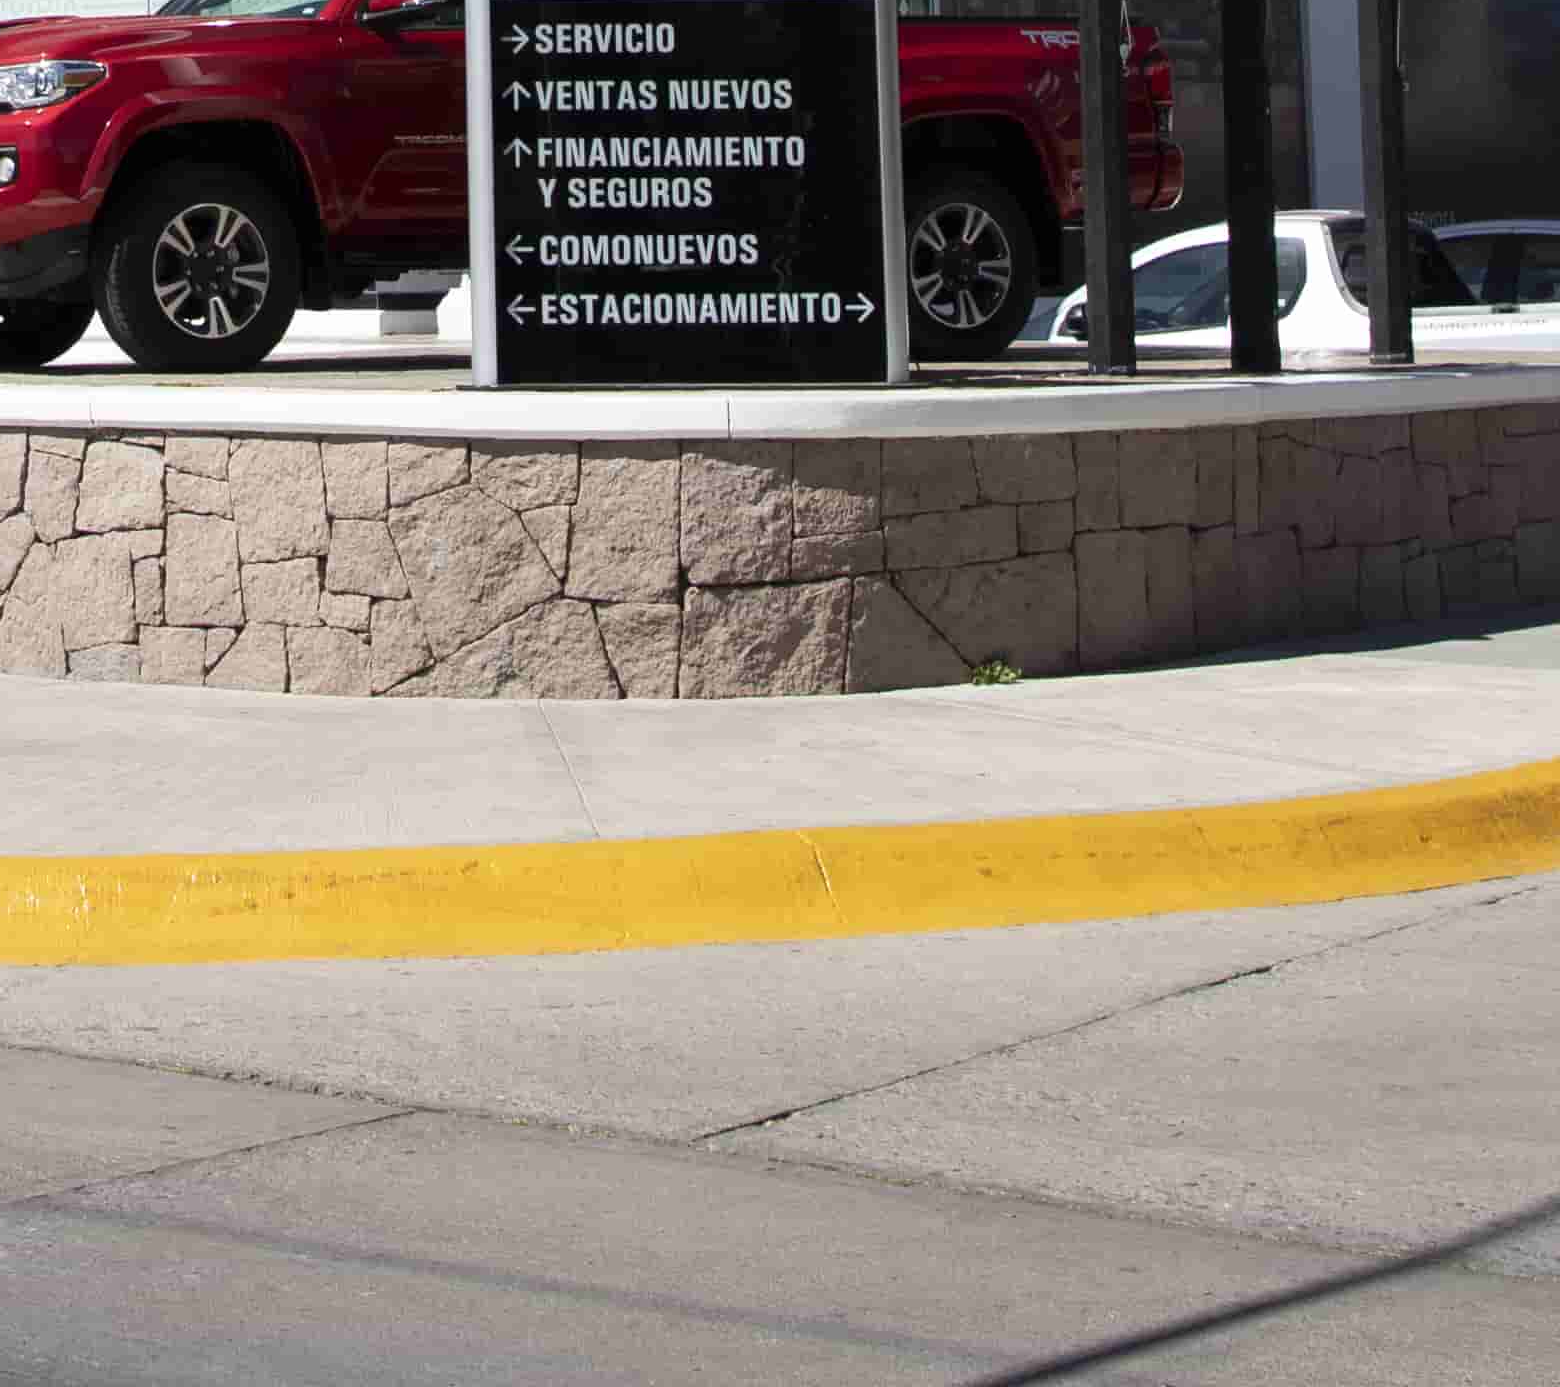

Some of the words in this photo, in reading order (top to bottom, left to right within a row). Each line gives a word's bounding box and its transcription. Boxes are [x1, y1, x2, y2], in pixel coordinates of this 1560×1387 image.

[535, 23, 676, 54] SERVICIO
[535, 80, 658, 112] VENTAS
[668, 79, 794, 111] NUEVOS
[537, 135, 806, 169] FINANCIAMIENTO
[538, 177, 558, 209] Y
[567, 177, 714, 209] SEGUROS
[538, 233, 761, 266] COMONUEVOS
[541, 292, 842, 325] ESTACIONAMIENTO
